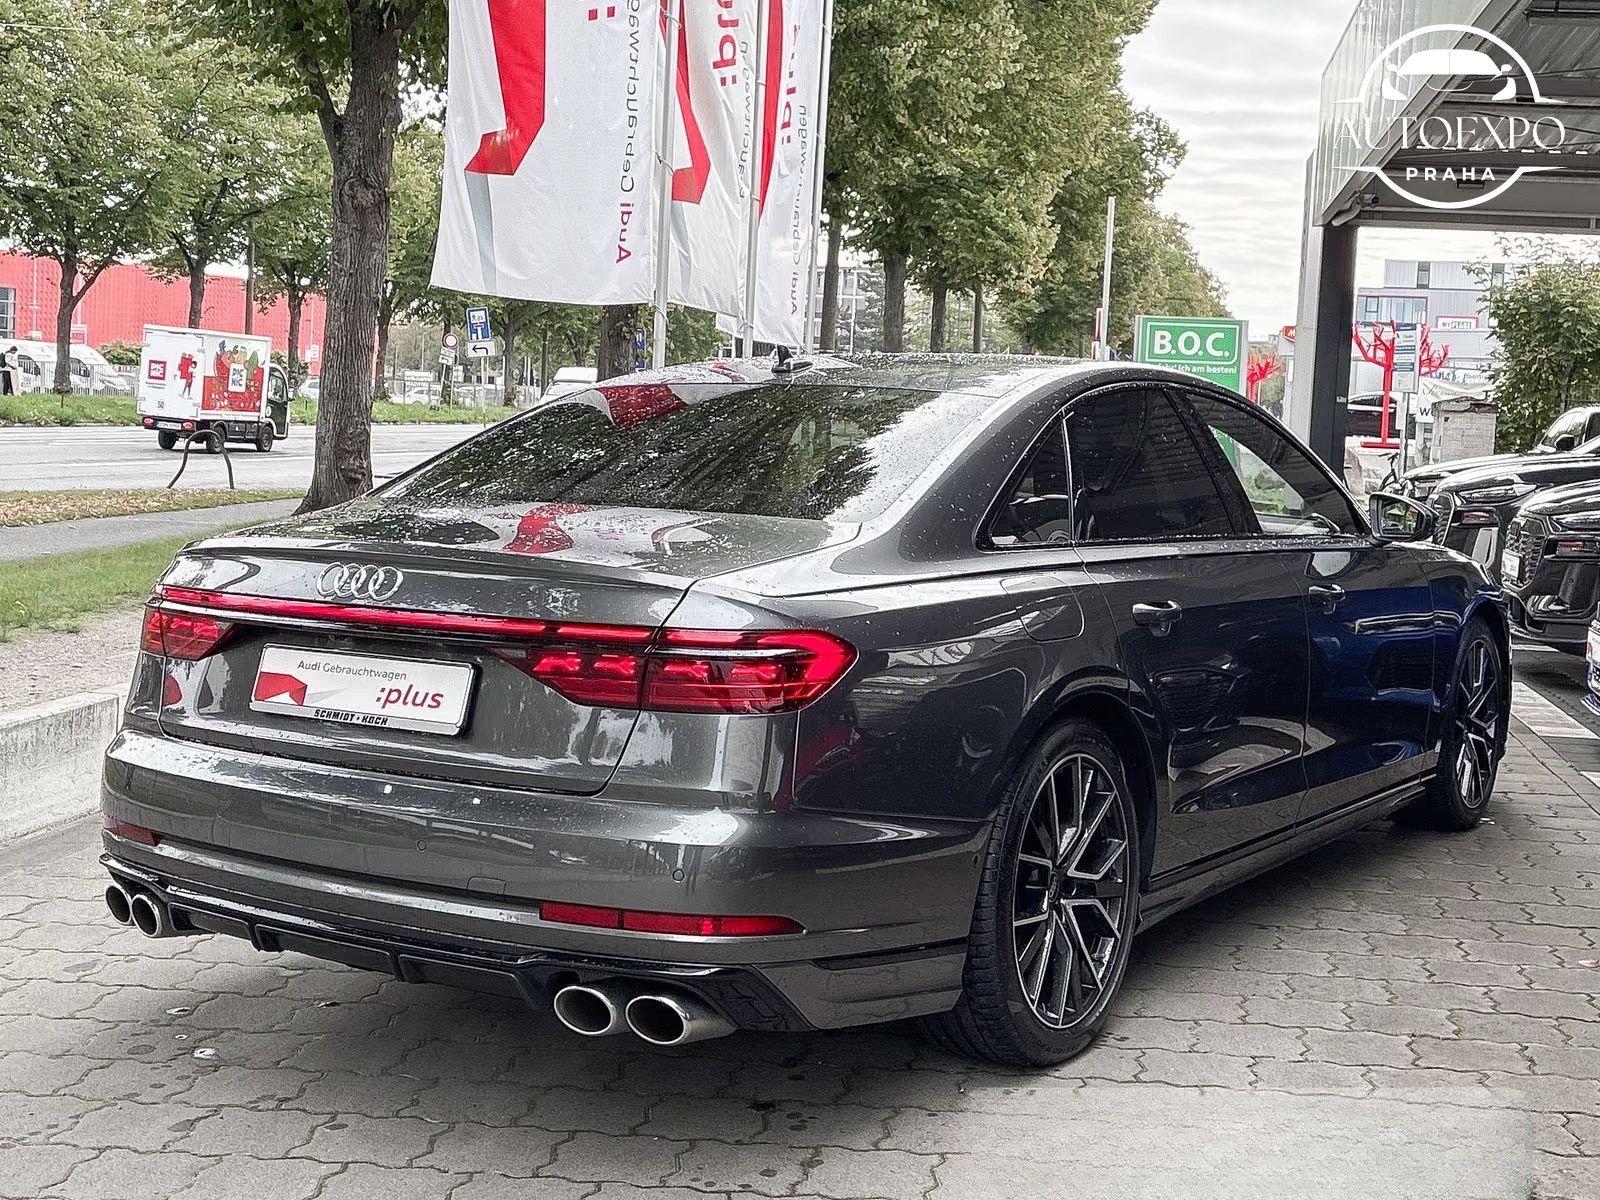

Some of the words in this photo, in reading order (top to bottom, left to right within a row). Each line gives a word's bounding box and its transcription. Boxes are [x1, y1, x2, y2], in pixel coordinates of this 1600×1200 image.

[1153, 330, 1230, 358] B.O.C.
[297, 660, 321, 671] Audi
[323, 662, 407, 681] Gebrauchtwagen
[376, 684, 444, 709] :plus
[314, 709, 356, 722] SCHMIDT
[361, 714, 389, 726] KOCH
